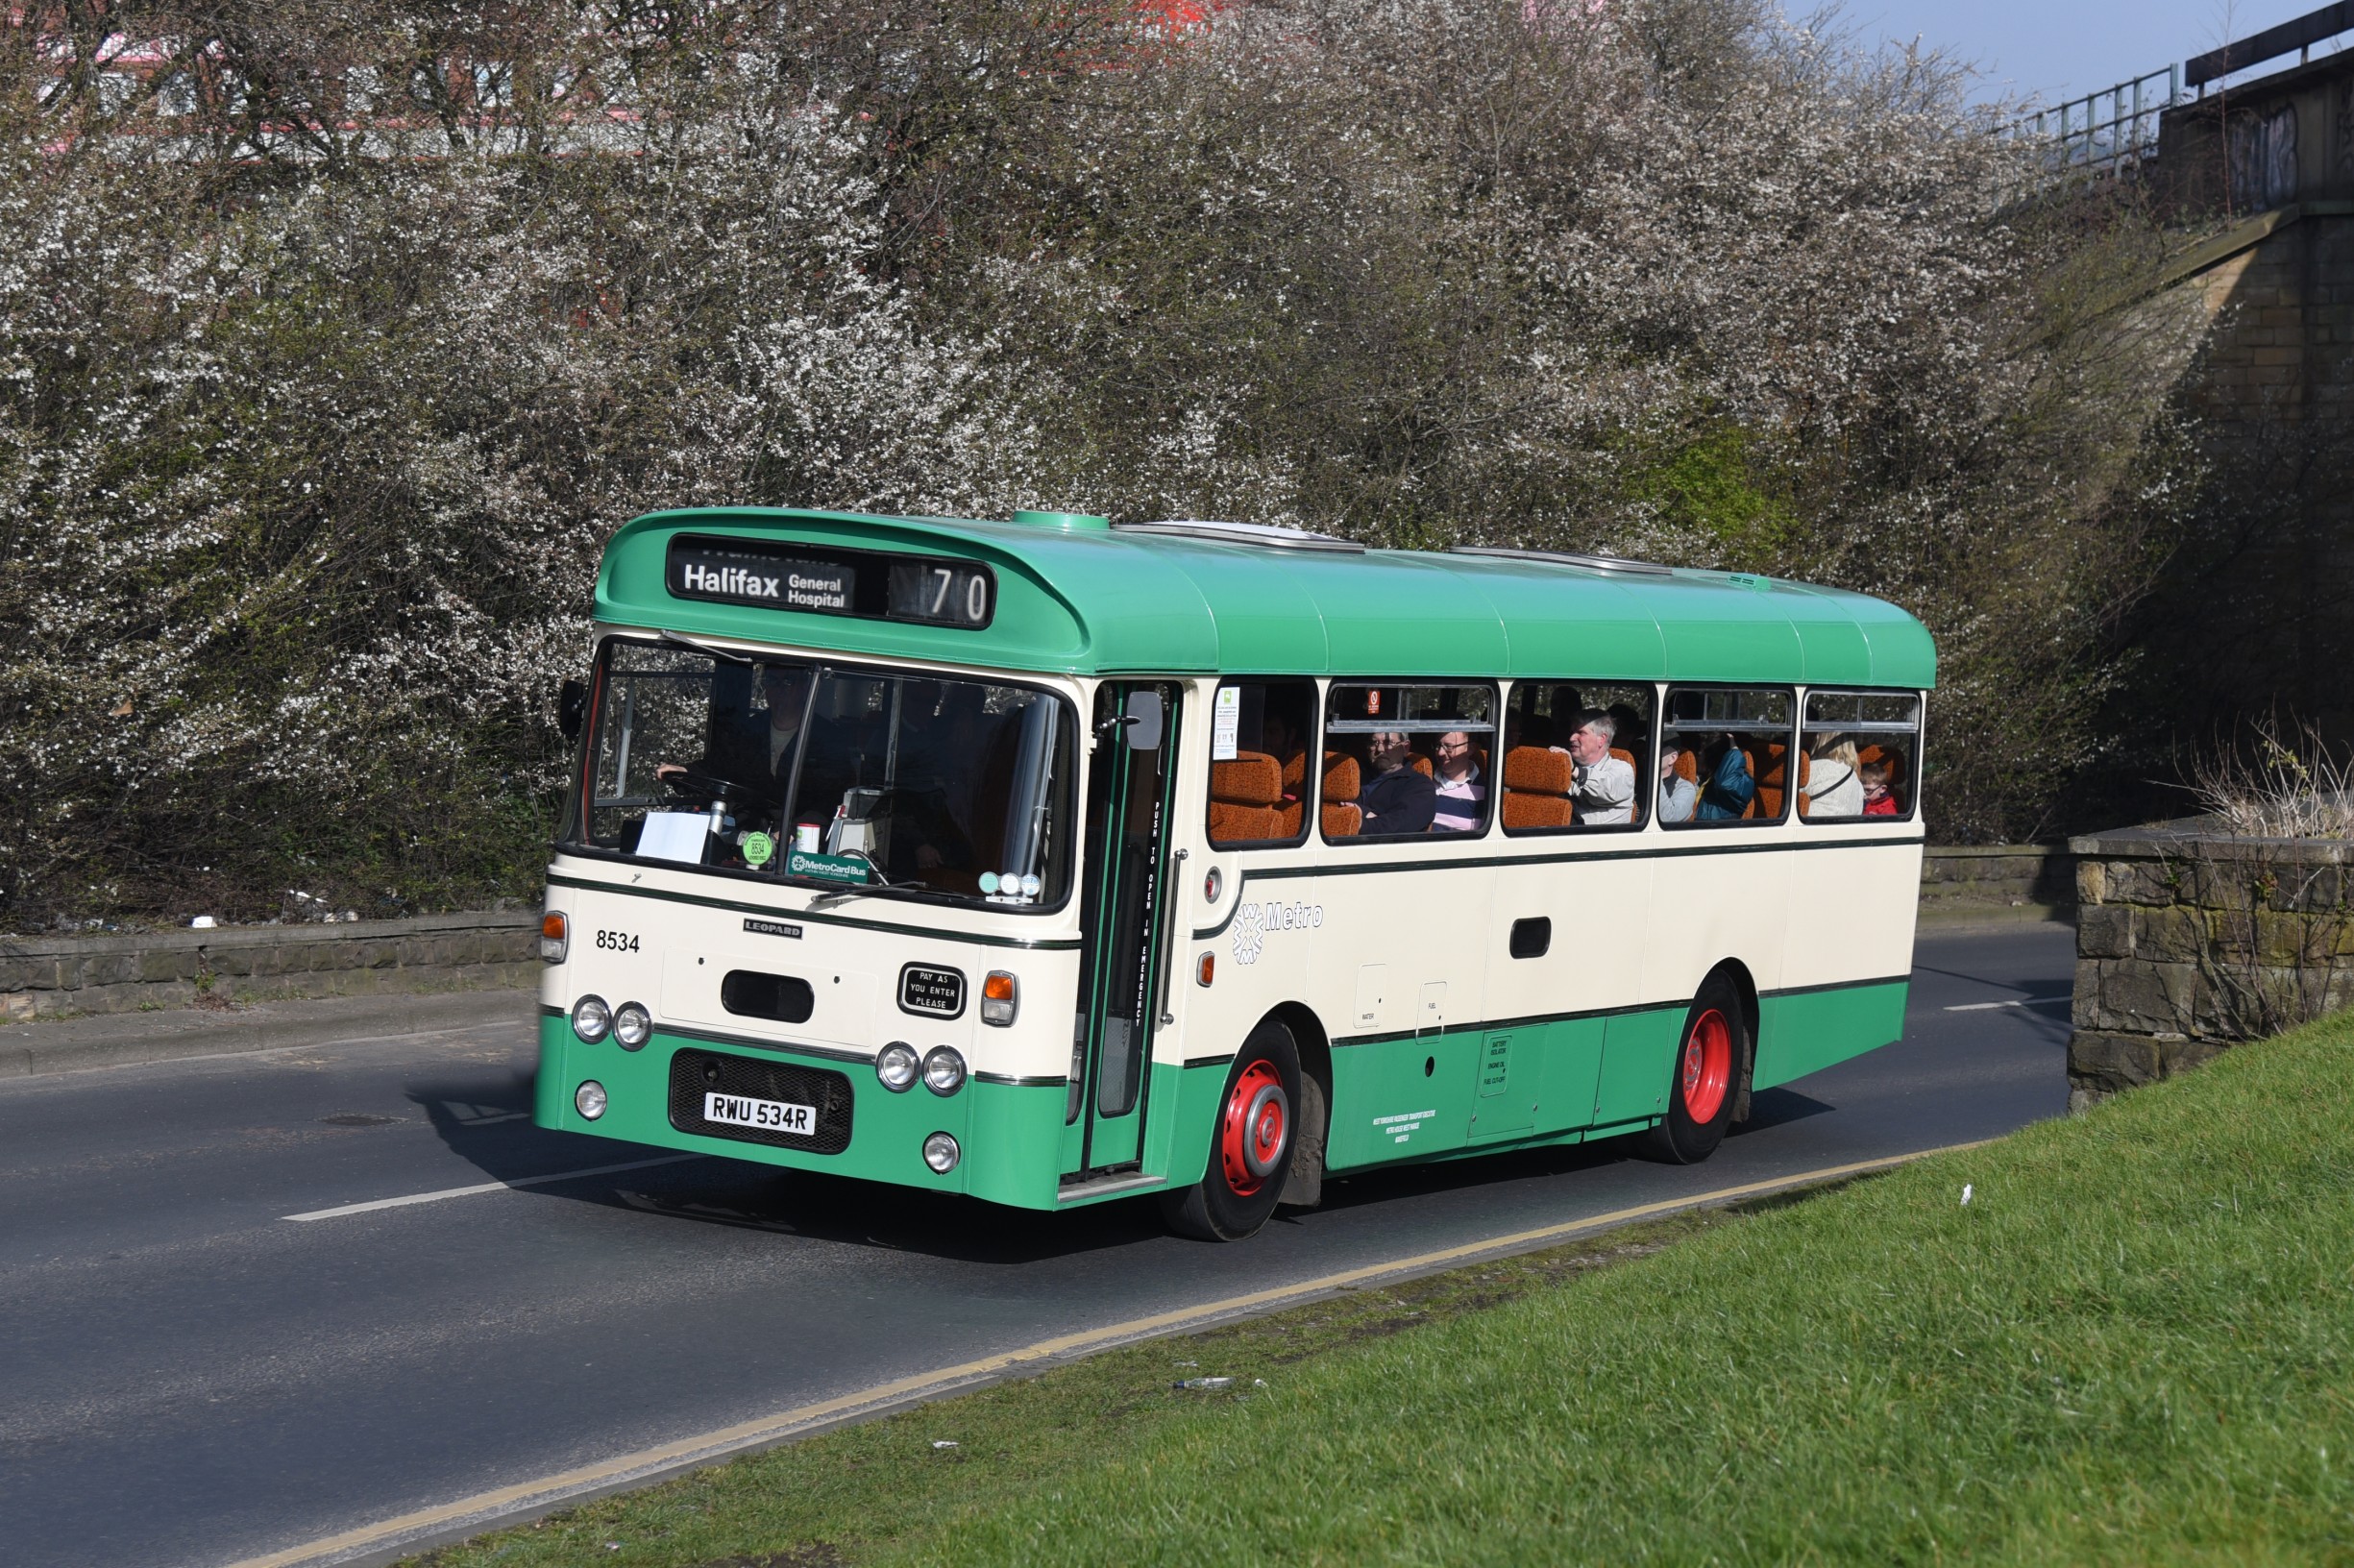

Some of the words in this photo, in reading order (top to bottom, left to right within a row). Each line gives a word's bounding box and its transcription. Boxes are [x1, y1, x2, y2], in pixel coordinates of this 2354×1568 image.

[684, 564, 779, 598] Halifax
[788, 574, 841, 592] General
[788, 589, 845, 608] Hospital
[751, 843, 765, 854] 8534
[1150, 846, 1156, 864] TO
[806, 860, 849, 874] MetroCard
[850, 866, 866, 876] Bus
[1145, 873, 1154, 909] OPEN
[1265, 901, 1323, 931] Metro
[746, 920, 800, 936] LEOPARD
[1143, 919, 1149, 936] IN
[596, 929, 640, 953] 8534
[920, 971, 933, 981] PAY
[937, 975, 948, 984] AS
[1136, 946, 1146, 1026] EMERGENCY
[910, 983, 925, 992] YOU
[929, 986, 955, 997] ENTER
[916, 996, 946, 1009] PLEASE
[713, 1096, 751, 1121] RWU
[756, 1103, 807, 1130] 534R
